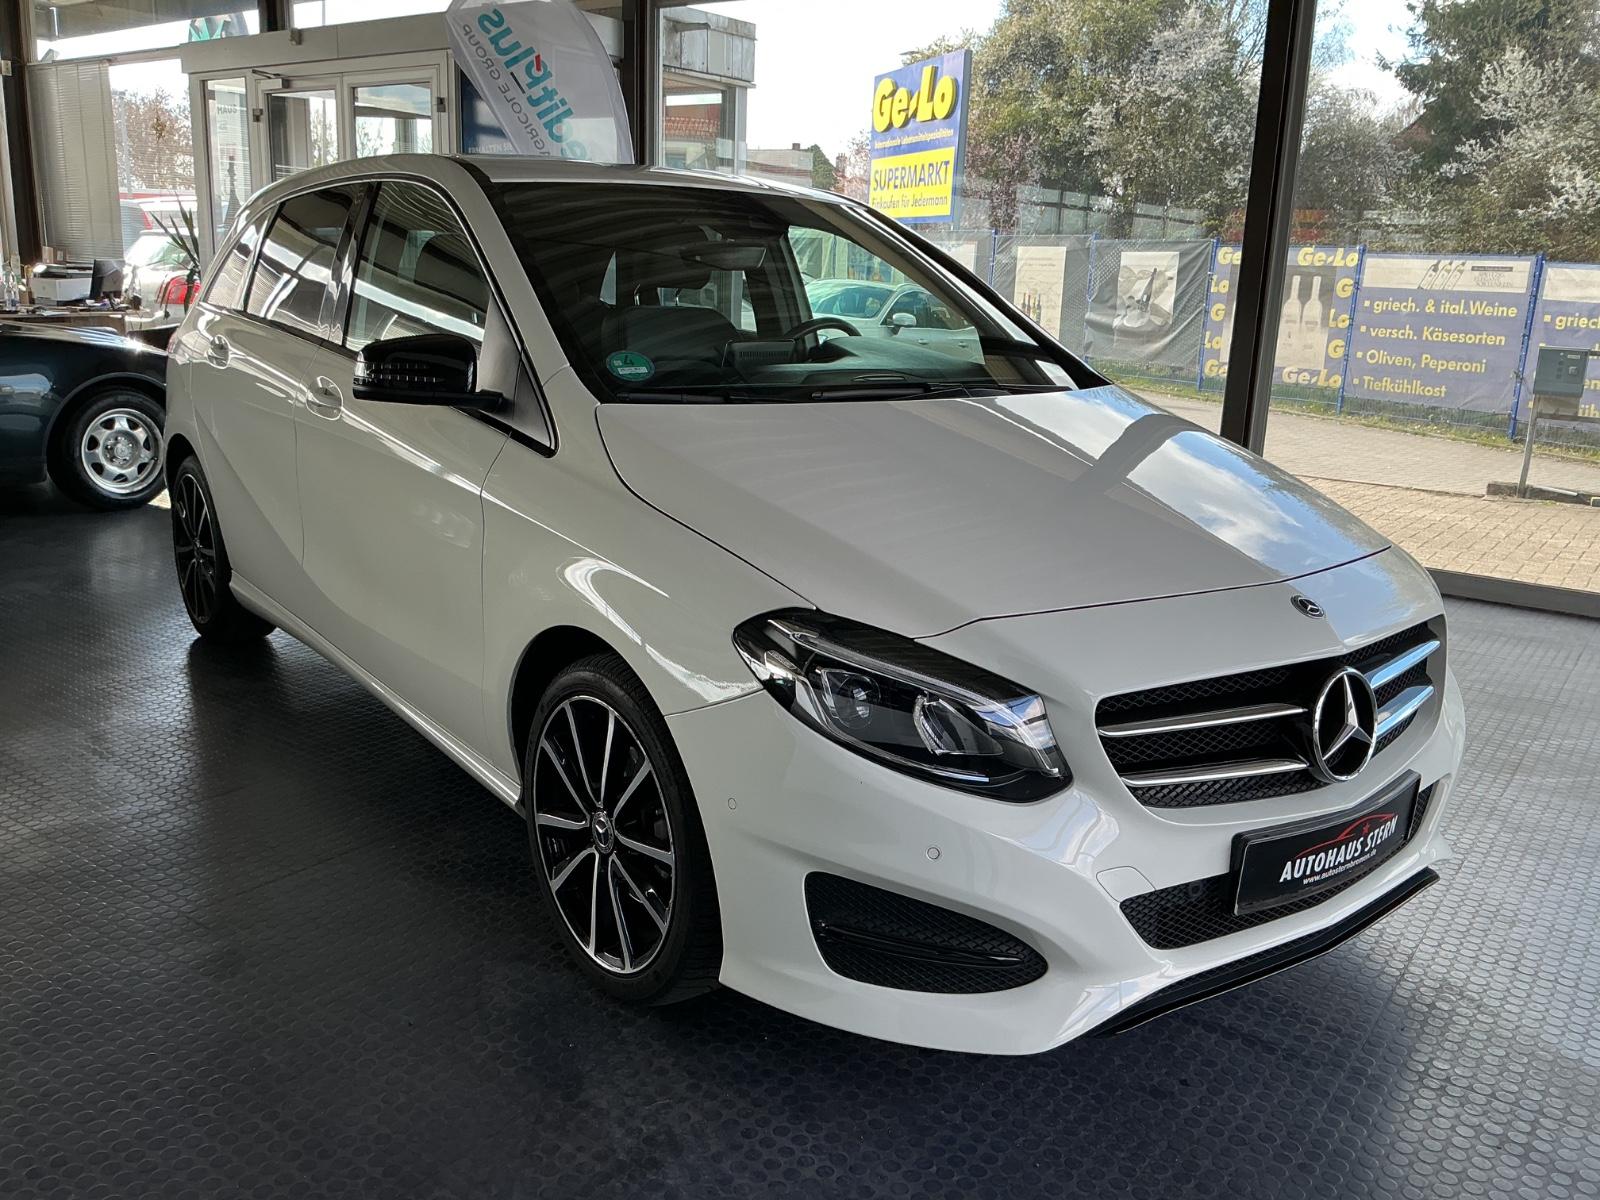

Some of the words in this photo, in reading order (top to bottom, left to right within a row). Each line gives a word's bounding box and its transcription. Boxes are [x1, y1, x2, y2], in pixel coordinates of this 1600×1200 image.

[873, 160, 950, 191] SUPERMARKT
[900, 193, 910, 208] für
[911, 192, 948, 208] Jedermann
[1373, 297, 1420, 313] griech.
[1425, 299, 1436, 313] &
[1555, 312, 1600, 330] griec
[1370, 325, 1418, 341] versch.
[1423, 325, 1506, 346] Käsesorten
[1366, 349, 1416, 369] Oliven,
[1420, 352, 1487, 373] Peperoni
[1362, 375, 1447, 397] Tiefkühlkost
[1279, 837, 1364, 882] AUTOHAUS
[1364, 815, 1398, 852] STERN
